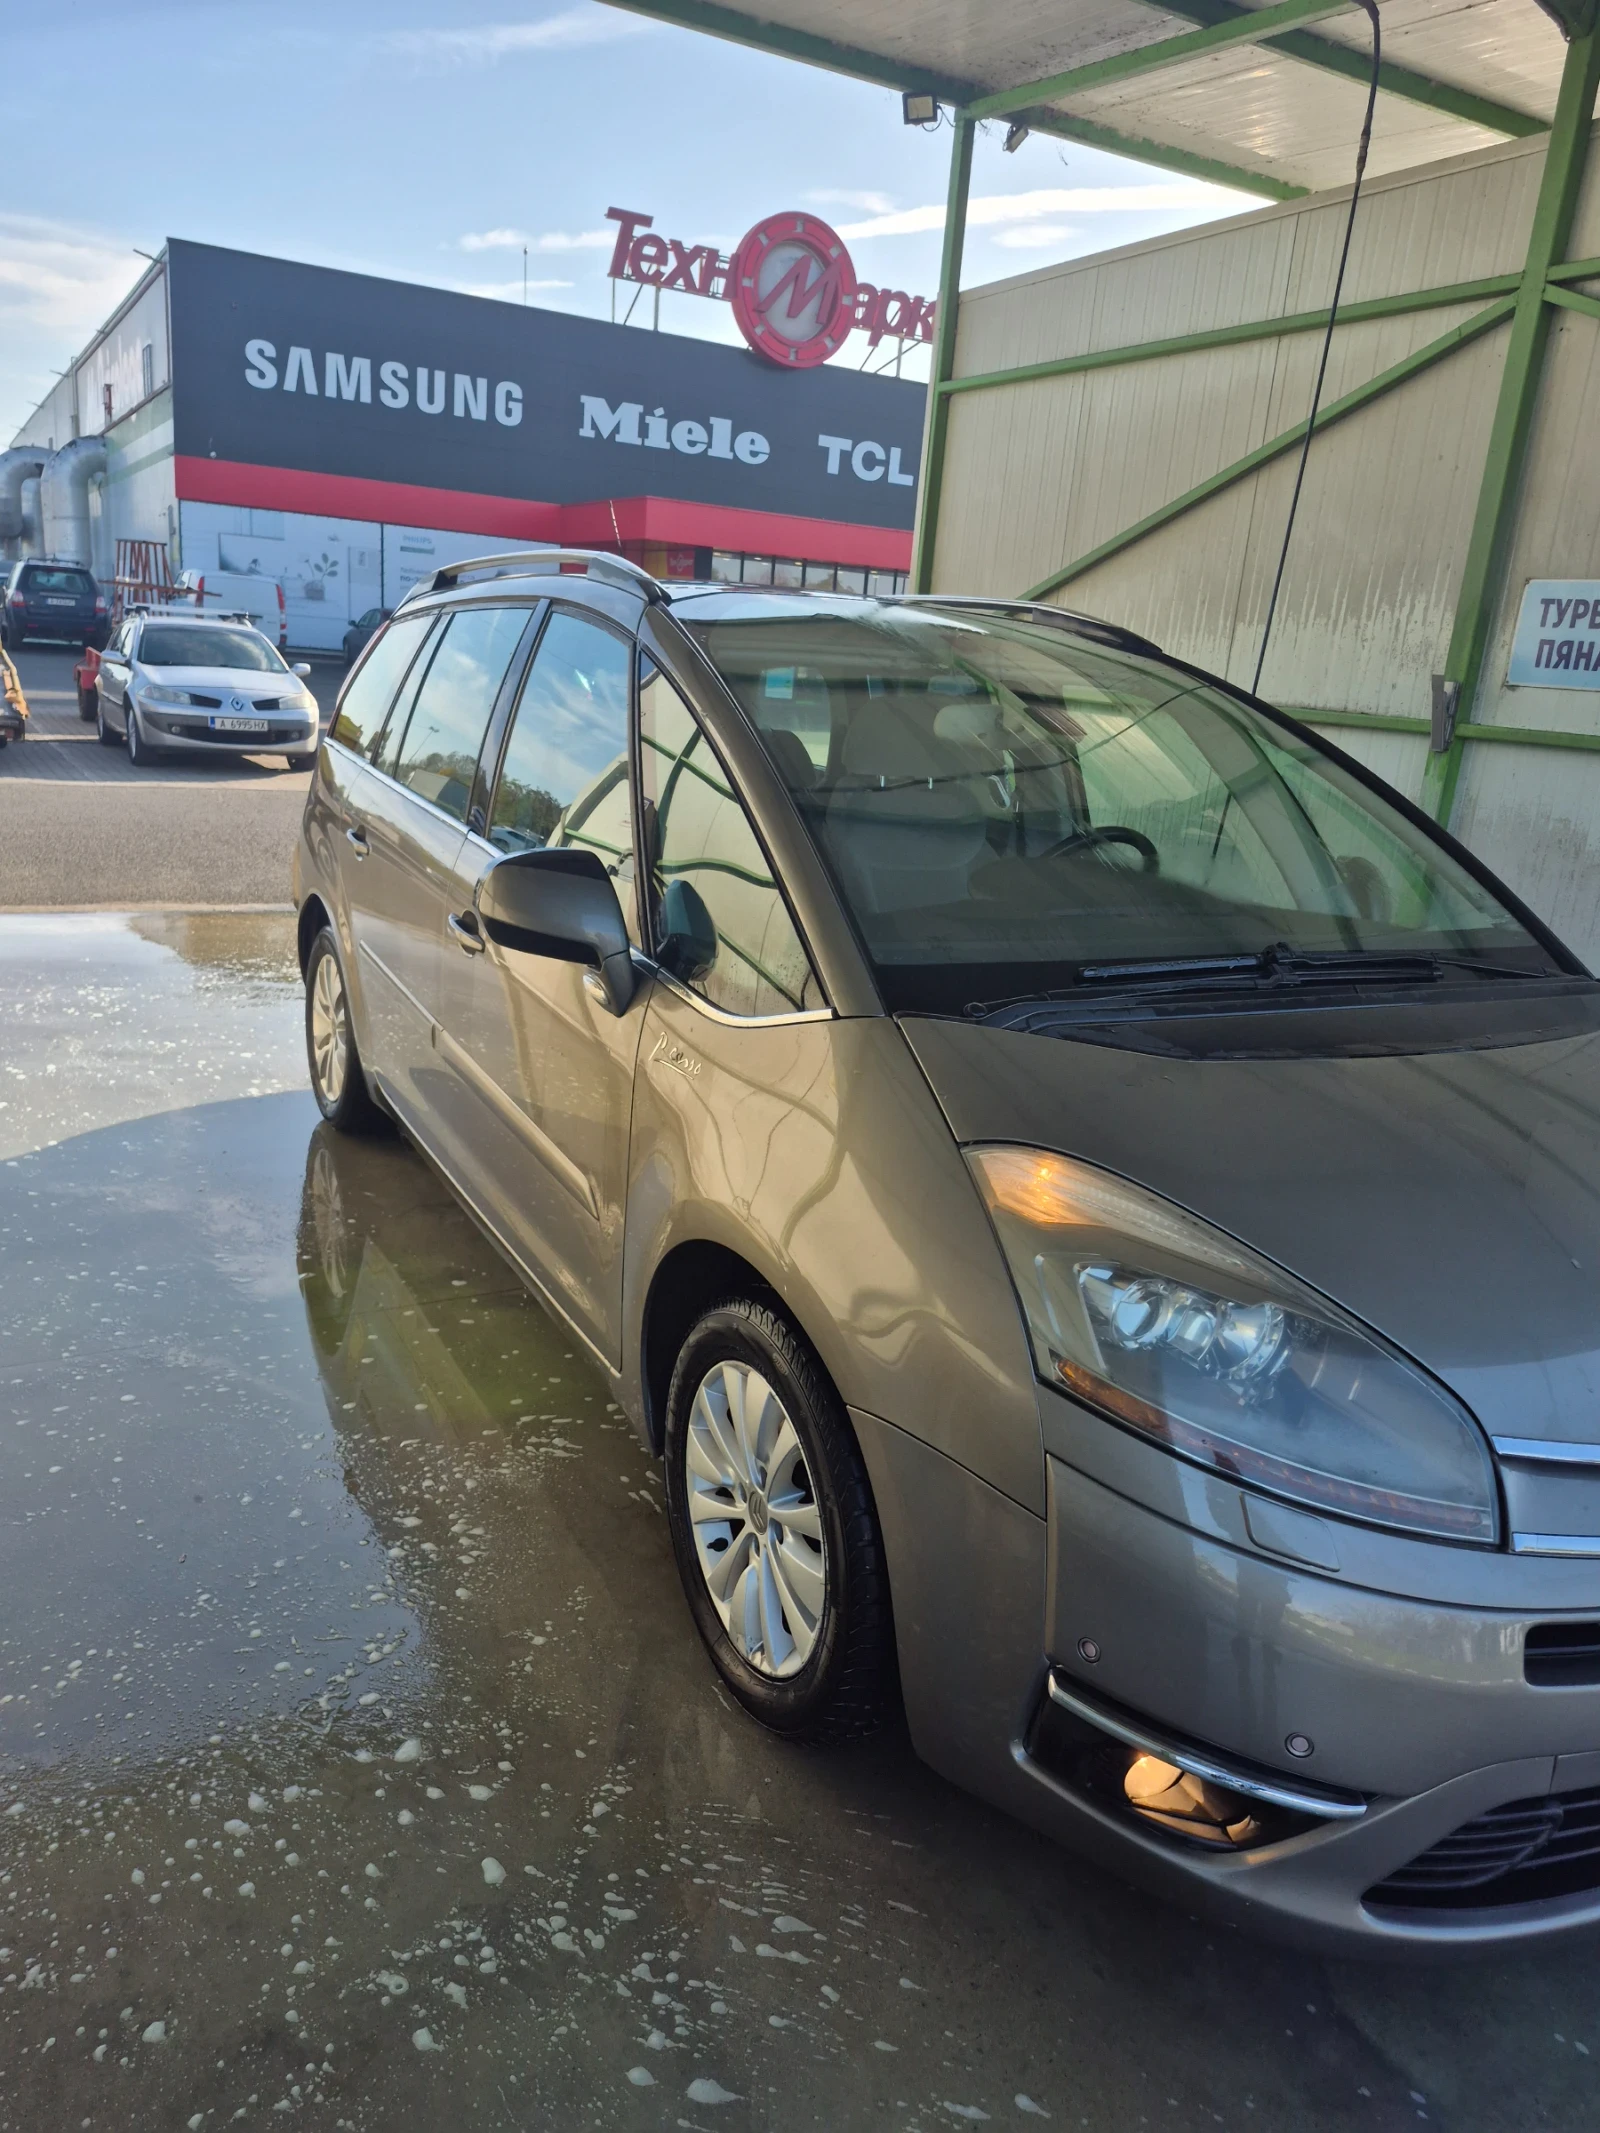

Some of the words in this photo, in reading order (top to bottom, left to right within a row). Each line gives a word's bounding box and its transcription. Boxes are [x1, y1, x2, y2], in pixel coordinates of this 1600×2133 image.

[244, 338, 524, 427] SAMSUNG
[579, 395, 770, 464] Miele
[817, 434, 914, 486] TCL
[647, 1031, 702, 1078] Pcasso
